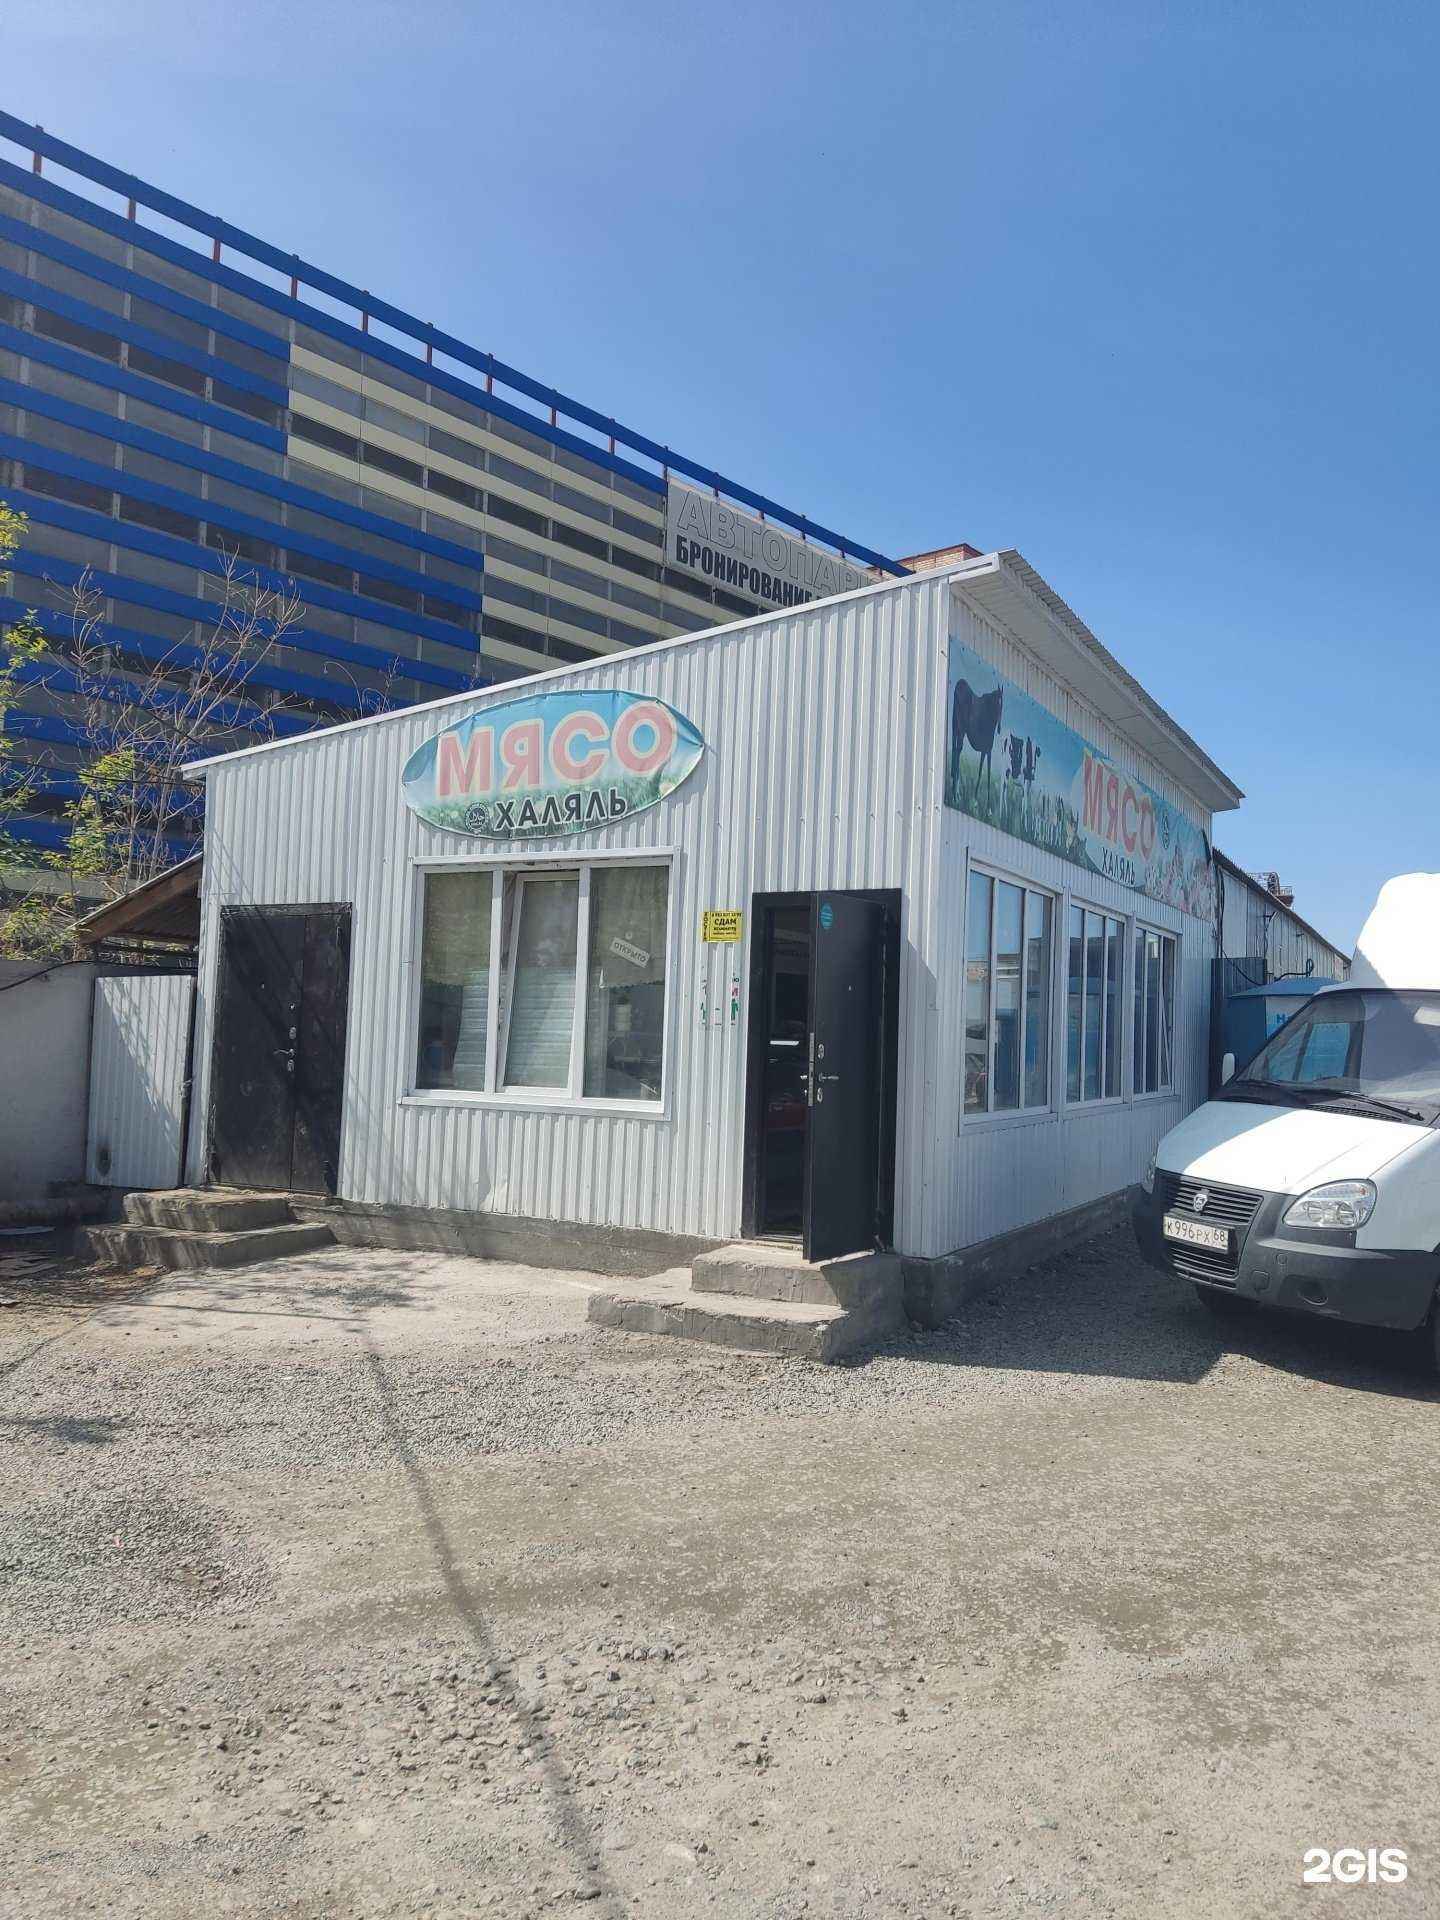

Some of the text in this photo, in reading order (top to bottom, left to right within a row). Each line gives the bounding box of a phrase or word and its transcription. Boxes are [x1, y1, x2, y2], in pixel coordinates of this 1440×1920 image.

[437, 702, 675, 797] МЯСО
[495, 788, 627, 831] ХАЛЯЛЬ
[1083, 753, 1156, 861] МЯСО
[1102, 847, 1135, 885] ХАЛЯЛЬ
